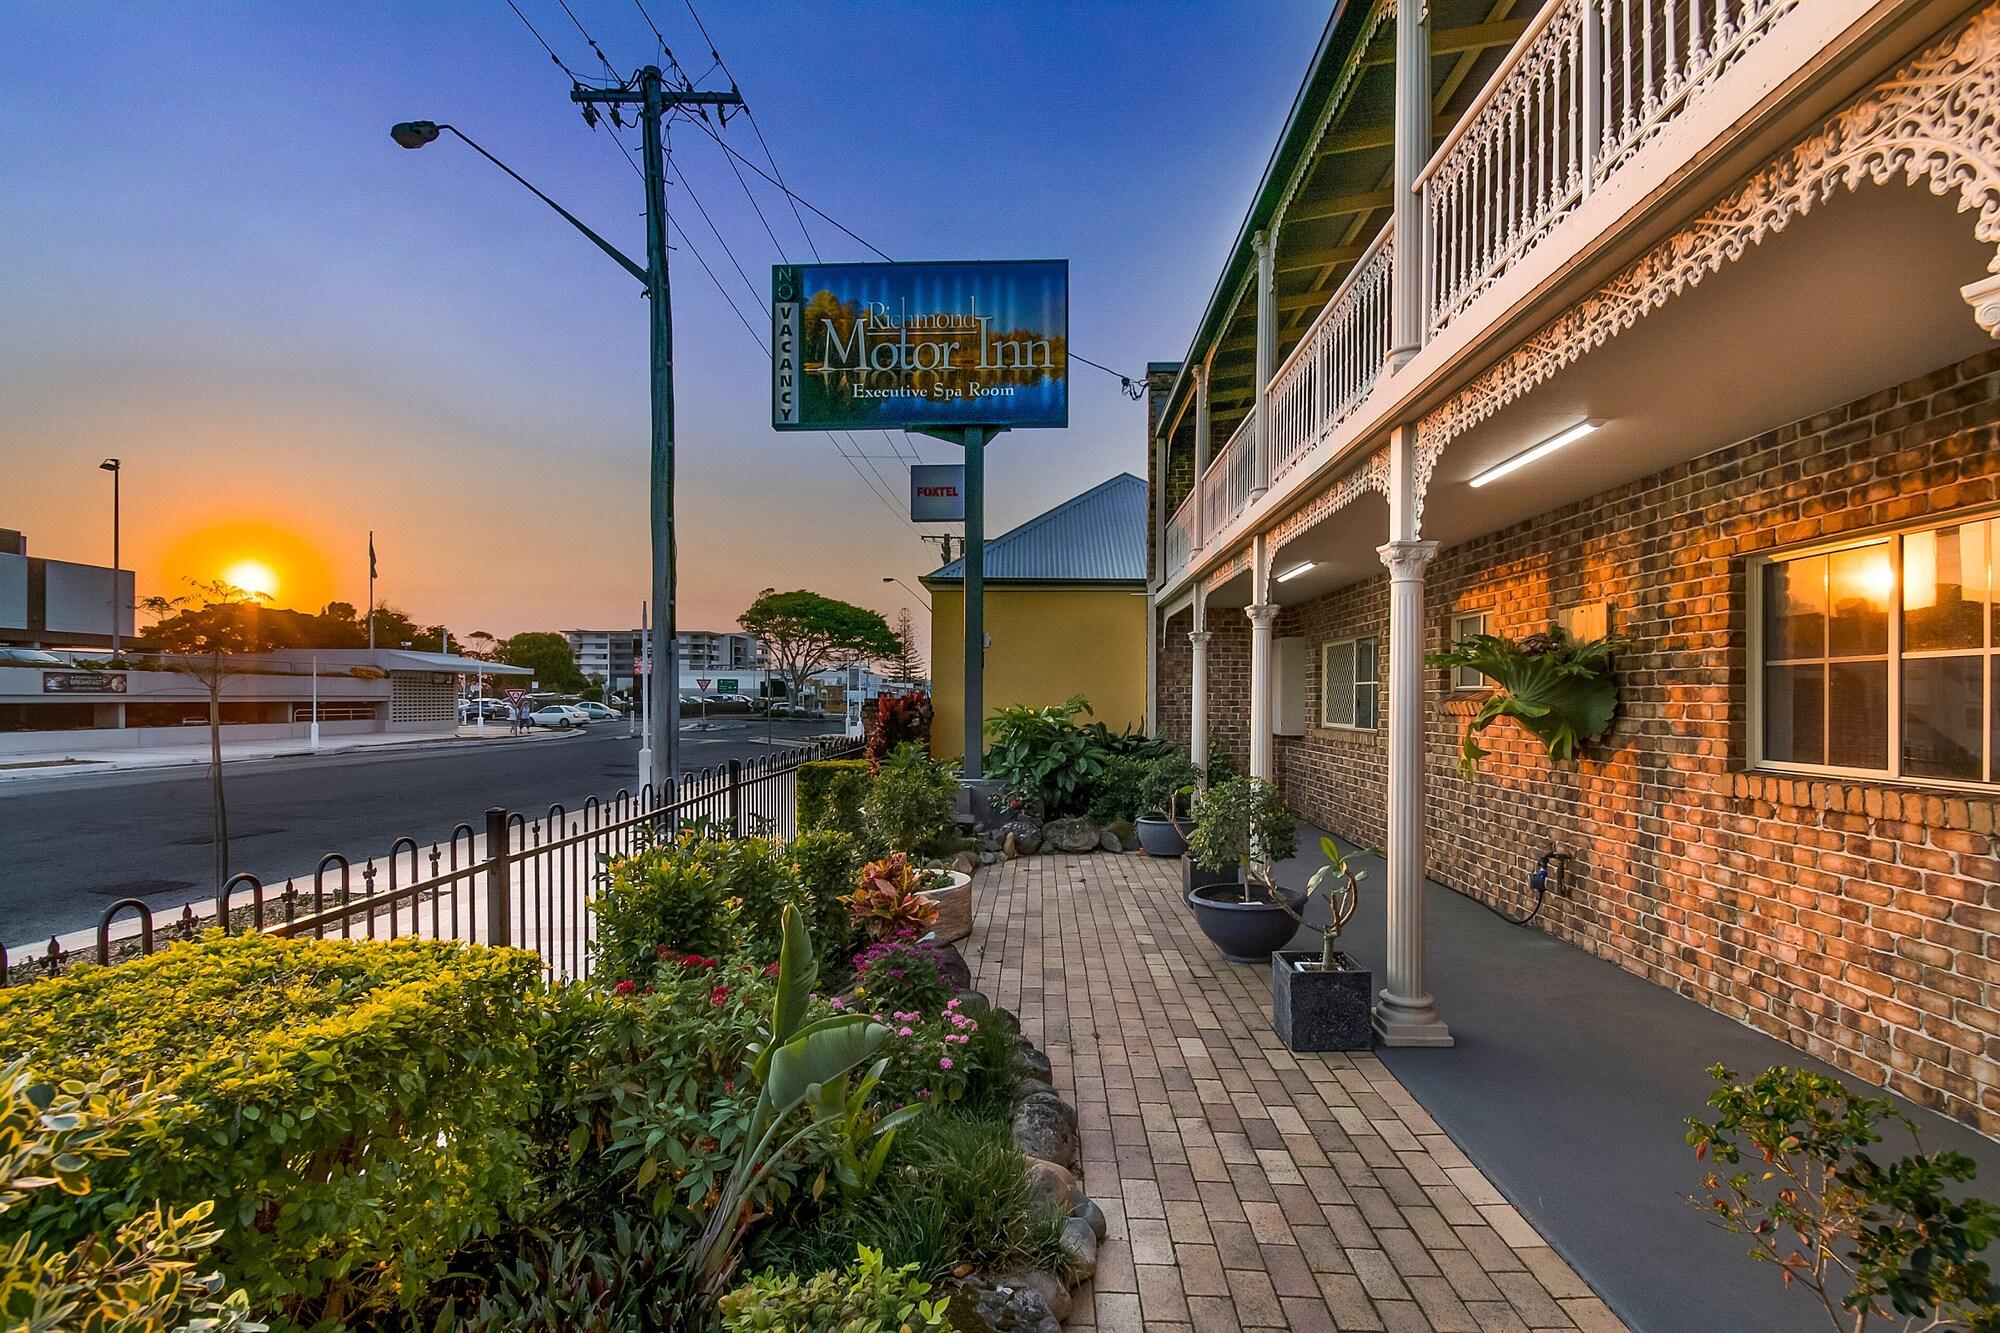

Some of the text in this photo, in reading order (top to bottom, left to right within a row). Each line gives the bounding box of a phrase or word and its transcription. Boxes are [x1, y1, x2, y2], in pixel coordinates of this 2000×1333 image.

[867, 296, 977, 330] Richmond
[778, 267, 793, 421] NO VACANCY
[820, 316, 1055, 372] Motor Inn
[853, 382, 1015, 401] Executive Spa Room
[916, 486, 959, 498] FOXTEL
